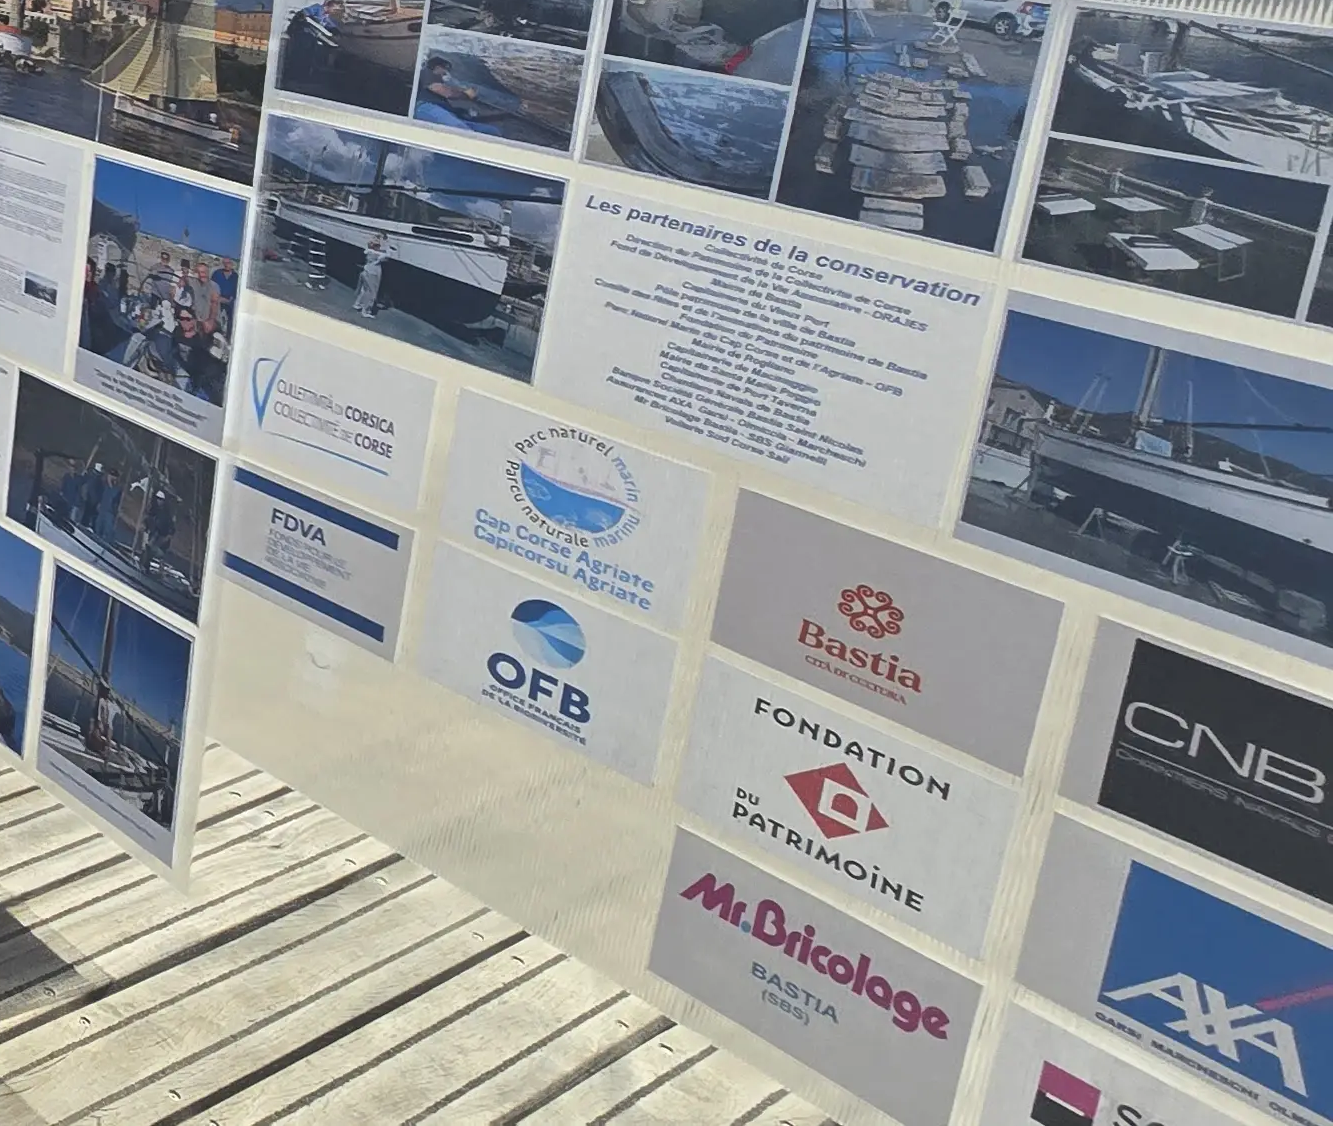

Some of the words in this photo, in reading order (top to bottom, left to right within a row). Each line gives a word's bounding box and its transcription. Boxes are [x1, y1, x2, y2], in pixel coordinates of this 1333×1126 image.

[585, 194, 622, 216] Les
[626, 207, 748, 249] partenaires
[753, 238, 782, 256] de
[787, 245, 809, 263] la
[815, 255, 981, 307] conservation
[345, 405, 395, 437] CORSICA
[354, 433, 393, 458] CORSE
[548, 427, 614, 456] naturel
[611, 456, 640, 502] marin
[271, 508, 326, 546] FDVA
[476, 509, 510, 534] Cap
[516, 525, 572, 558] Corse
[576, 550, 654, 593] Agriate
[522, 505, 589, 548] naturale
[474, 524, 568, 575] Capicorsu
[573, 567, 652, 610] Agriate
[487, 652, 590, 723] OFB
[797, 618, 922, 693] Bastia
[754, 697, 950, 801] FONDATION
[1125, 702, 1326, 804] CNB
[736, 787, 760, 806] DU
[750, 962, 839, 1023] BASTIA
[761, 988, 810, 1025] (SBS)
[1102, 973, 1309, 1098] AXA
